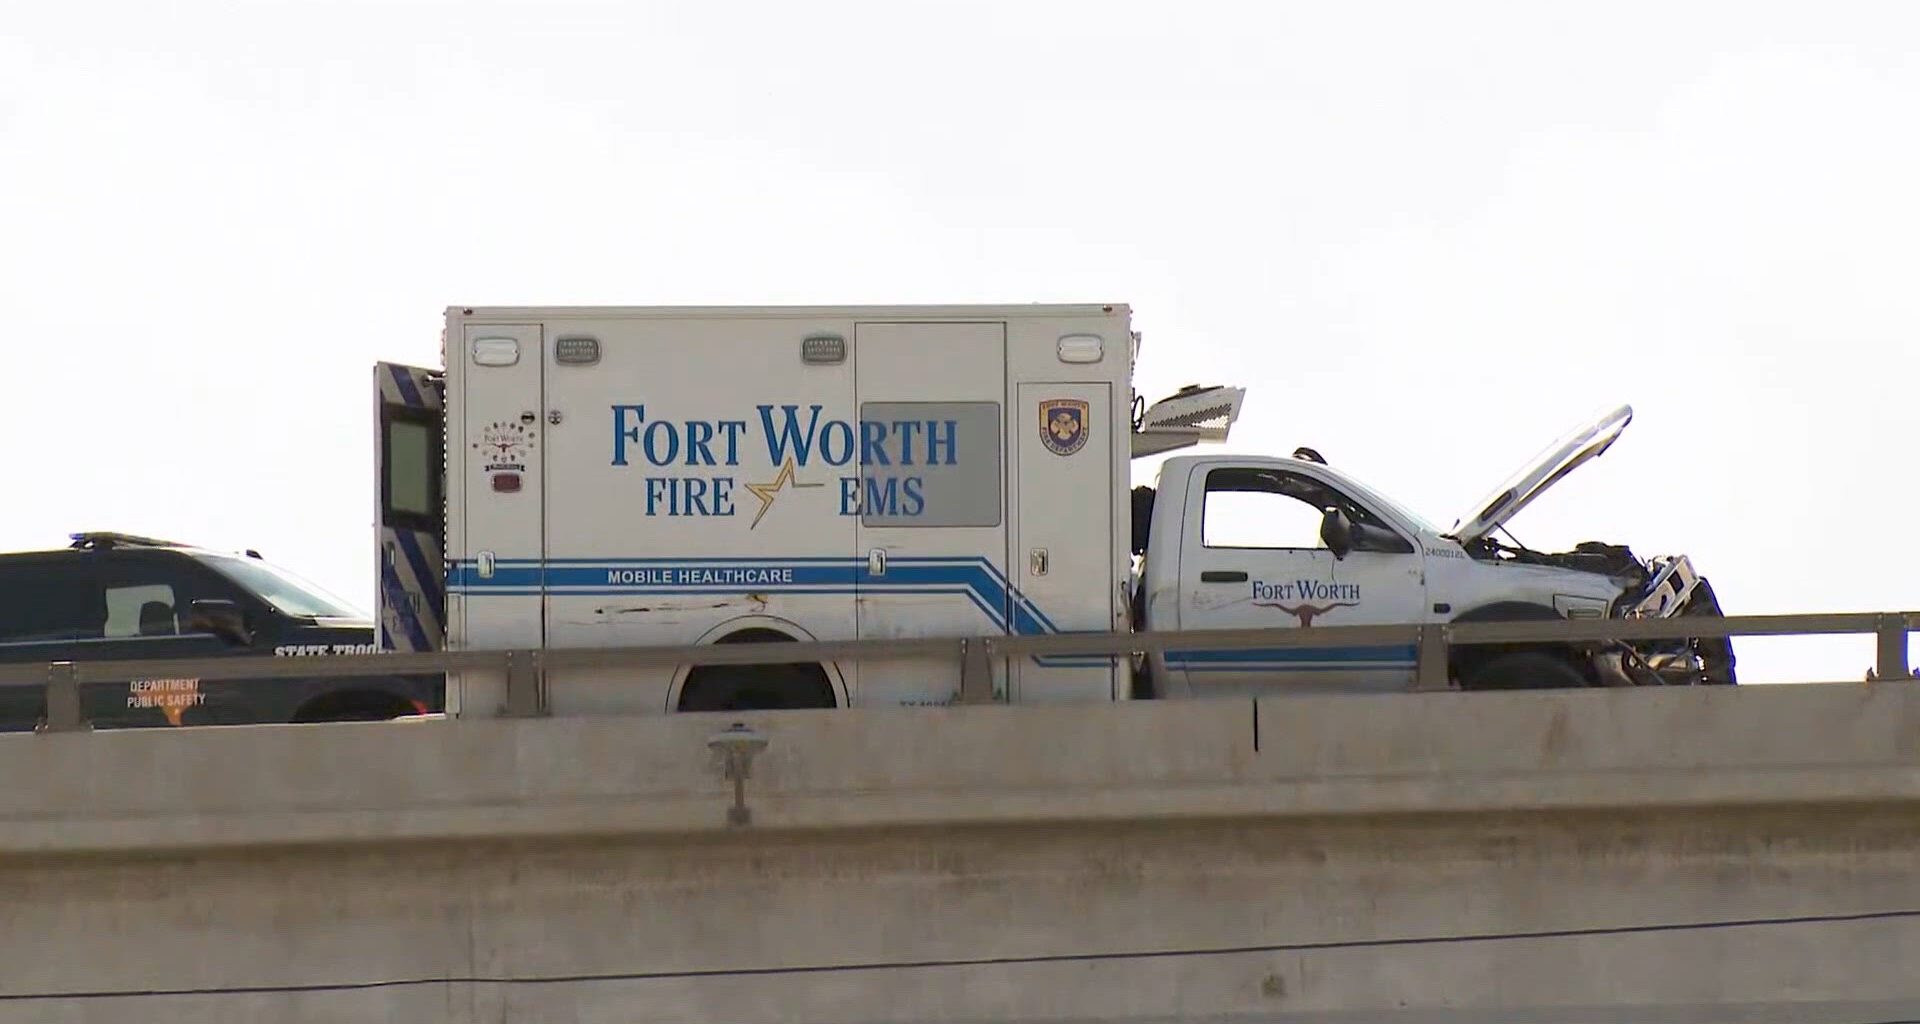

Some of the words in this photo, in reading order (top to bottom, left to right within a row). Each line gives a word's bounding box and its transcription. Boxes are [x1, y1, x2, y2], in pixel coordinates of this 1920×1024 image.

[611, 404, 746, 466] FORT
[756, 404, 959, 467] WORTH
[645, 477, 735, 516] FIRE
[839, 477, 925, 516] EMS
[607, 569, 673, 584] MOBILE
[678, 568, 793, 584] HEALTHCARE
[1252, 580, 1294, 600] FORT
[1296, 580, 1360, 600] WORTH
[274, 644, 329, 656] STATE
[332, 643, 384, 656] TROO
[130, 679, 199, 692] DEPARTMENT
[127, 695, 165, 708] PUBLIC
[166, 693, 206, 707] SAFETY
